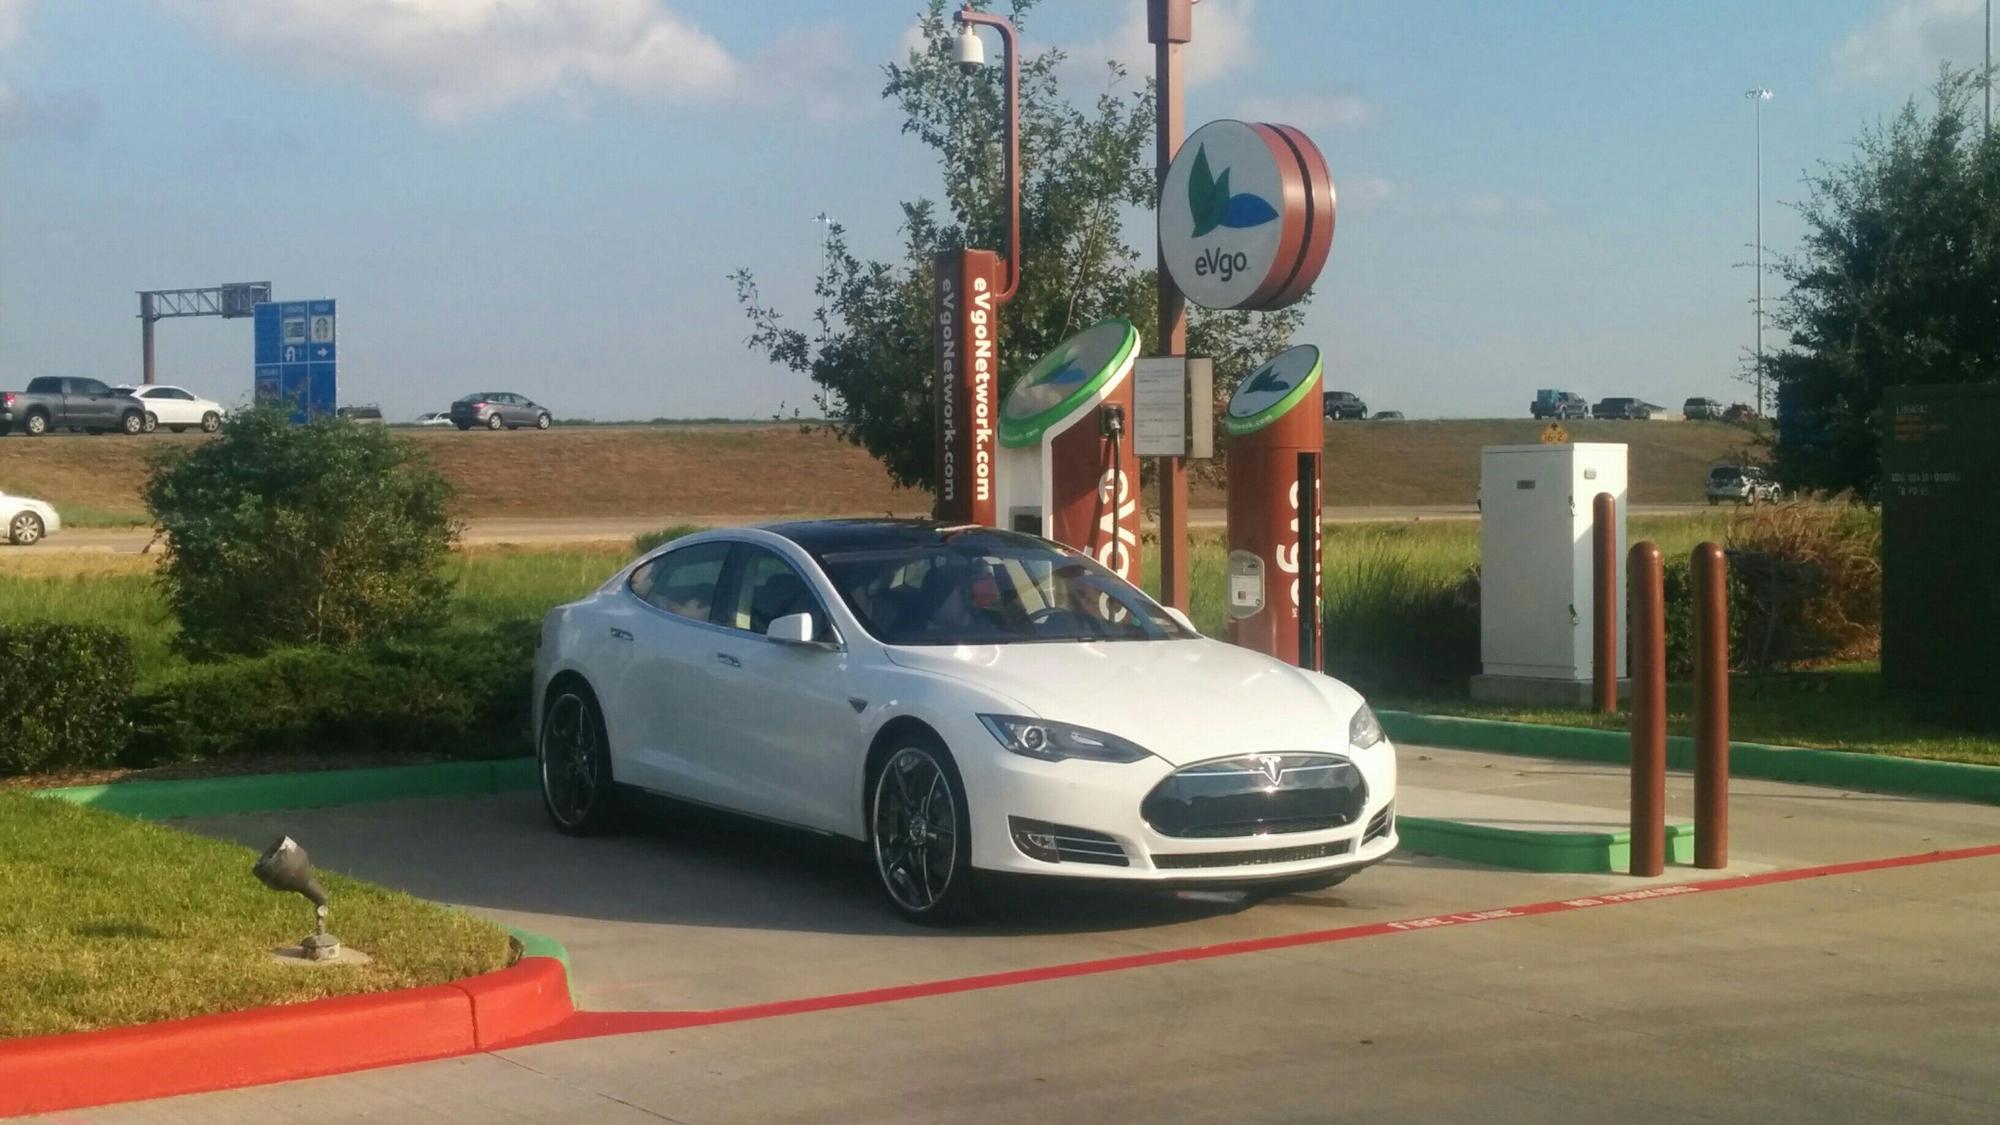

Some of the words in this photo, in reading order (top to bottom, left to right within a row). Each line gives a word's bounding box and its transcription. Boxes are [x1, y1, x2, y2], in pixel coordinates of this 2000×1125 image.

[1195, 247, 1248, 282] eVgo
[940, 278, 956, 501] eVgoNetwork.com
[970, 277, 993, 501] eVgoNetwork.com
